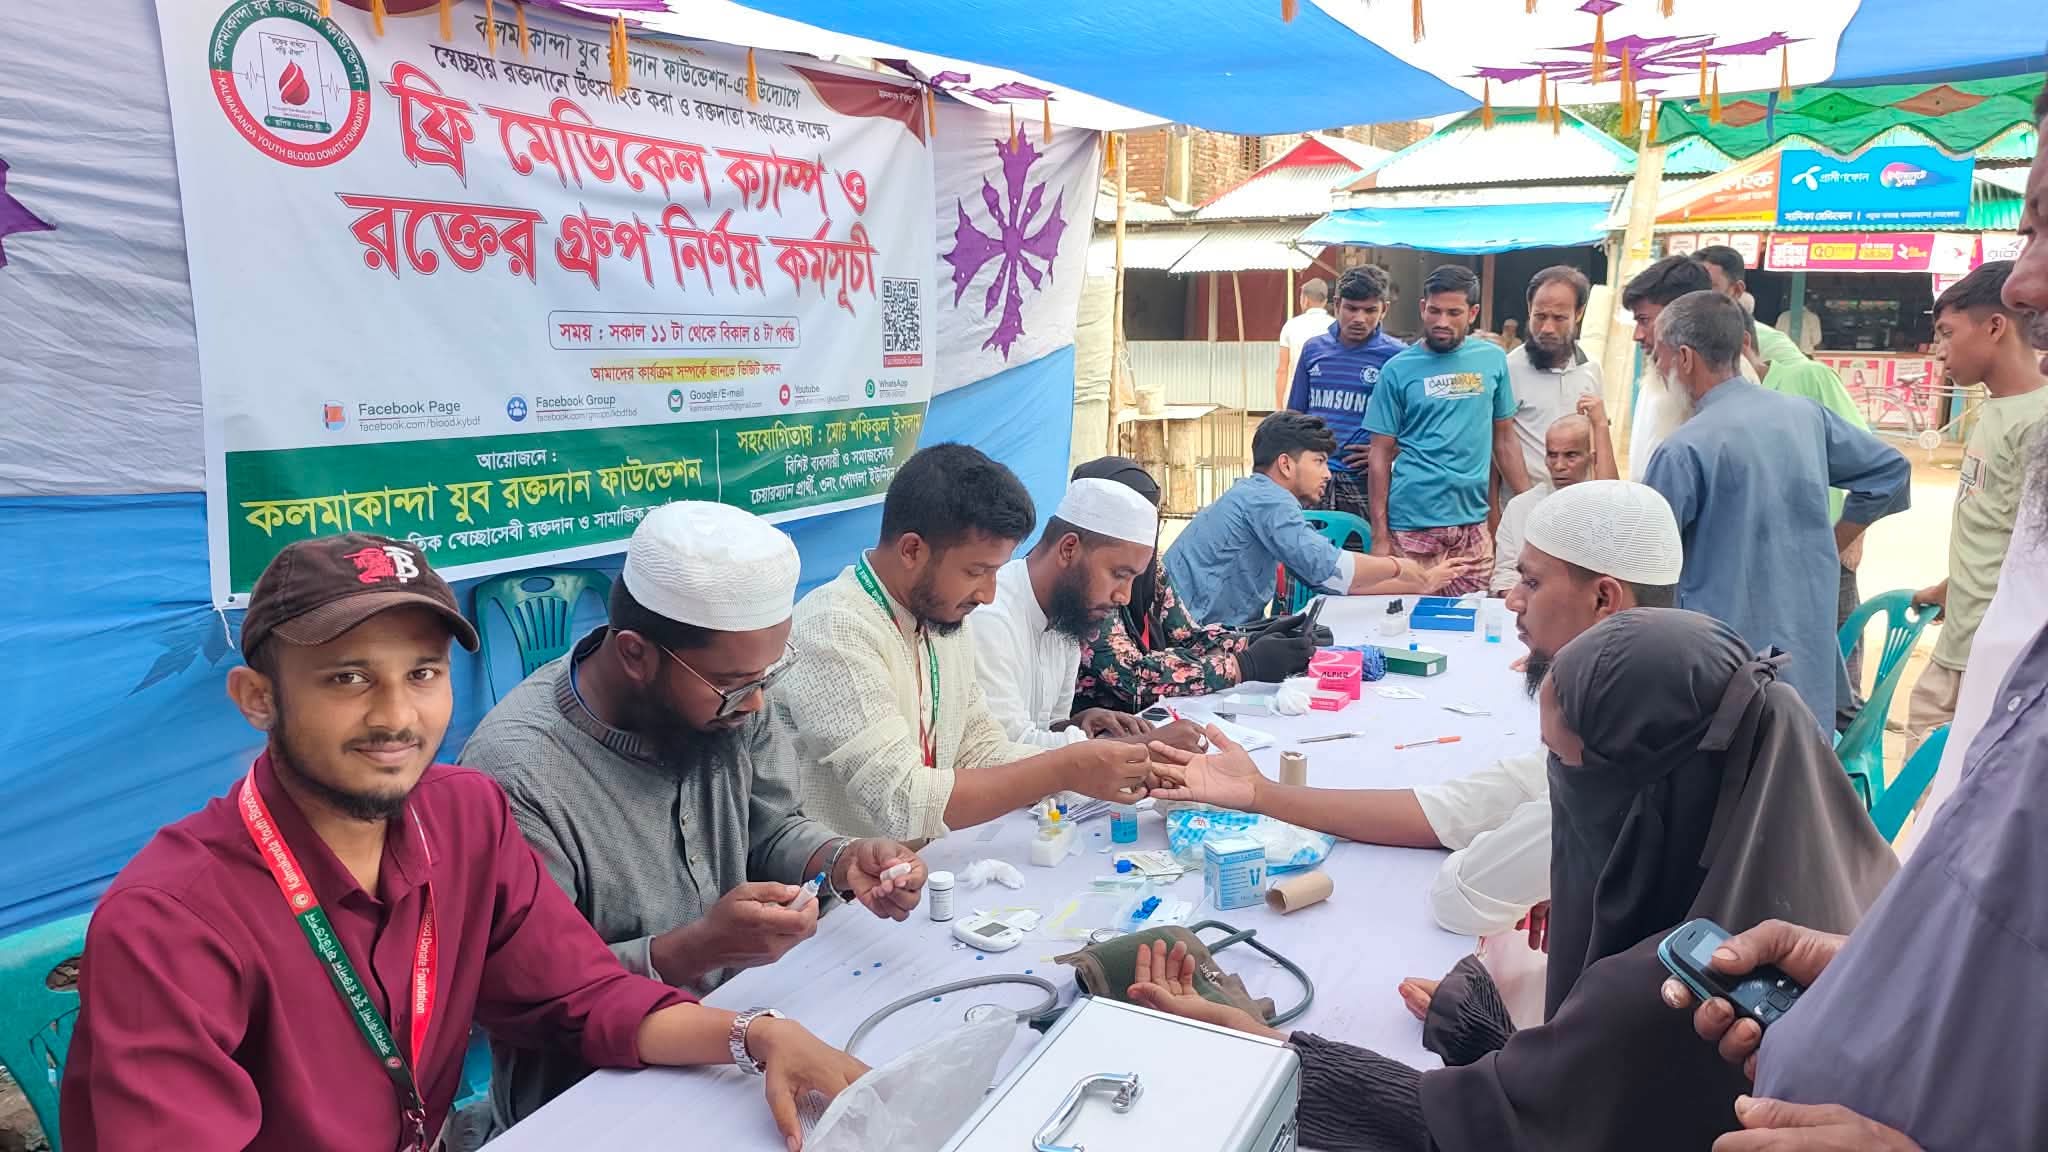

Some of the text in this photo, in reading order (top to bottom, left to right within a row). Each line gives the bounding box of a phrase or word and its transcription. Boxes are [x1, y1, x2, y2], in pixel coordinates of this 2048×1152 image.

[473, 14, 572, 60] কলমকান্দা
[576, 38, 602, 70] যুব
[428, 42, 498, 81] স্বেচ্ছায়
[500, 60, 571, 96] রক্তদানে
[645, 89, 673, 116] করা
[679, 96, 690, 116] ও
[693, 99, 745, 128] রক্তদাতা
[748, 110, 796, 137] সংগ্রহের
[796, 120, 831, 142] লক্ষ্যে
[217, 77, 257, 138] KALMAKANDA
[257, 134, 286, 157] YOUTH
[287, 150, 316, 161] BLOOD
[317, 142, 347, 161] DONATE
[343, 96, 366, 145] FOUNDATION
[380, 61, 867, 218] ফ্রি মেডিকেল ক্যাম্প ও
[334, 192, 881, 318] রক্তের গ্রুপ নির্ণয় কর্মসূচী
[558, 323, 593, 343] সময়
[608, 322, 647, 343] সকাল
[651, 324, 667, 343] ১১
[671, 320, 685, 343] টা
[688, 323, 717, 343] থেকে
[720, 321, 751, 344] বিকাল
[753, 327, 760, 341] ৪
[763, 323, 773, 341] টা
[775, 325, 796, 343] পর্যন্ত
[590, 367, 634, 382] আমাদের
[638, 362, 674, 381] কার্যক্রম
[676, 362, 709, 380] সম্পর্কে
[710, 364, 736, 377] জানতে
[358, 401, 461, 416] Facebook Page
[536, 394, 616, 408] Facebook Group
[689, 388, 745, 402] Google/E-mail
[1309, 387, 1370, 413] SAMSUN
[736, 420, 814, 455] সহযোগিতায়
[475, 449, 548, 471] আয়োজনে
[842, 453, 849, 466] ও
[240, 455, 704, 537] কলমাকান্দা যুব রক্তদান ফাউন্ডেশন
[448, 519, 524, 550] স্বেচ্ছাসেবী
[527, 516, 574, 539] রক্তদান
[579, 517, 589, 530] ও
[594, 505, 645, 529] সামাজিক
[255, 815, 278, 843] Youth
[266, 841, 301, 891] Kalmakanda
[418, 938, 432, 966] Donate
[416, 967, 430, 1014] Foundation
